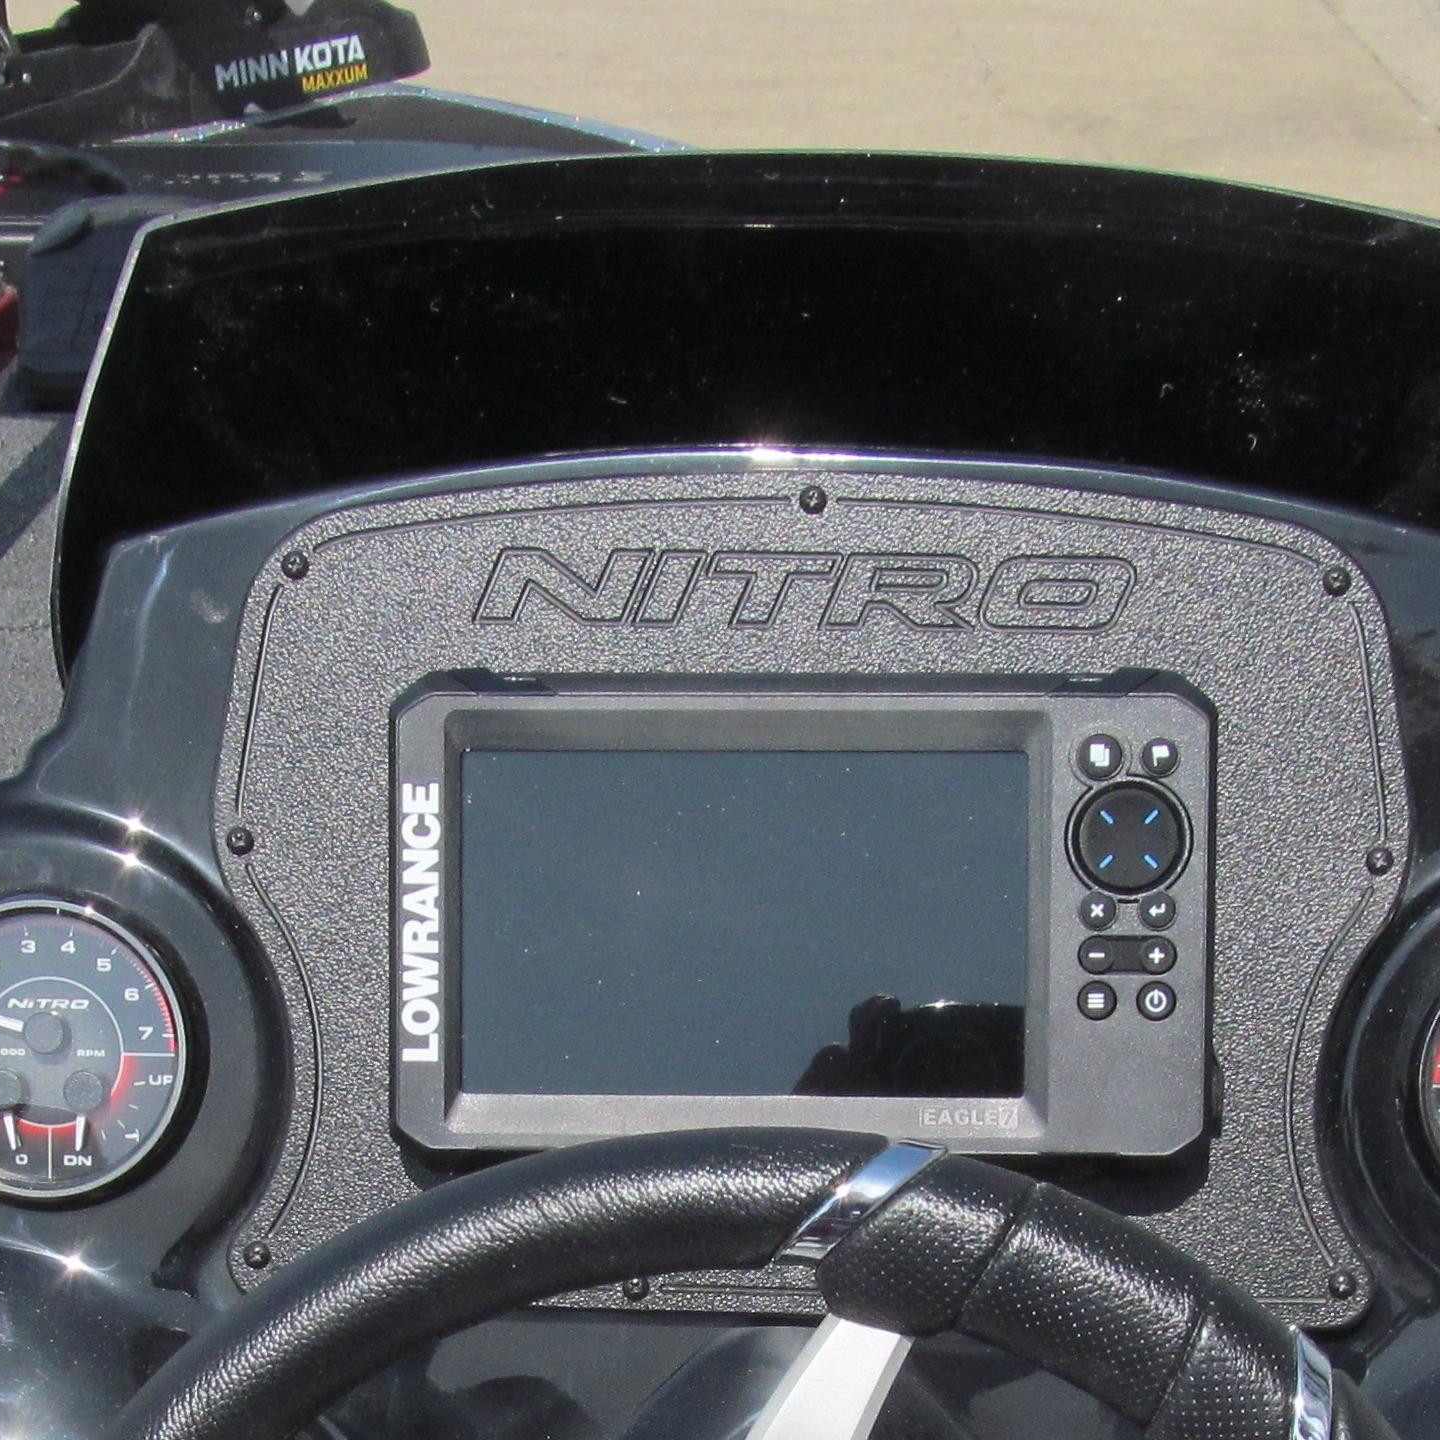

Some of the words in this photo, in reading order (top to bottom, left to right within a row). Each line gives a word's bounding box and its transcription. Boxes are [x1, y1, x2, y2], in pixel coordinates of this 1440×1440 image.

[214, 50, 289, 90] MINN
[294, 34, 365, 73] KOTA
[302, 64, 368, 93] MAXXUM
[473, 547, 1137, 632] NITRO
[402, 782, 441, 1064] LOWRANCE
[21, 939, 35, 954] 3
[61, 940, 76, 954] 4
[97, 958, 112, 972] 5
[124, 988, 139, 1002] 6
[138, 1027, 152, 1041] 7
[77, 1049, 106, 1059] RPM
[149, 1074, 174, 1087] UP
[64, 1154, 93, 1167] DN
